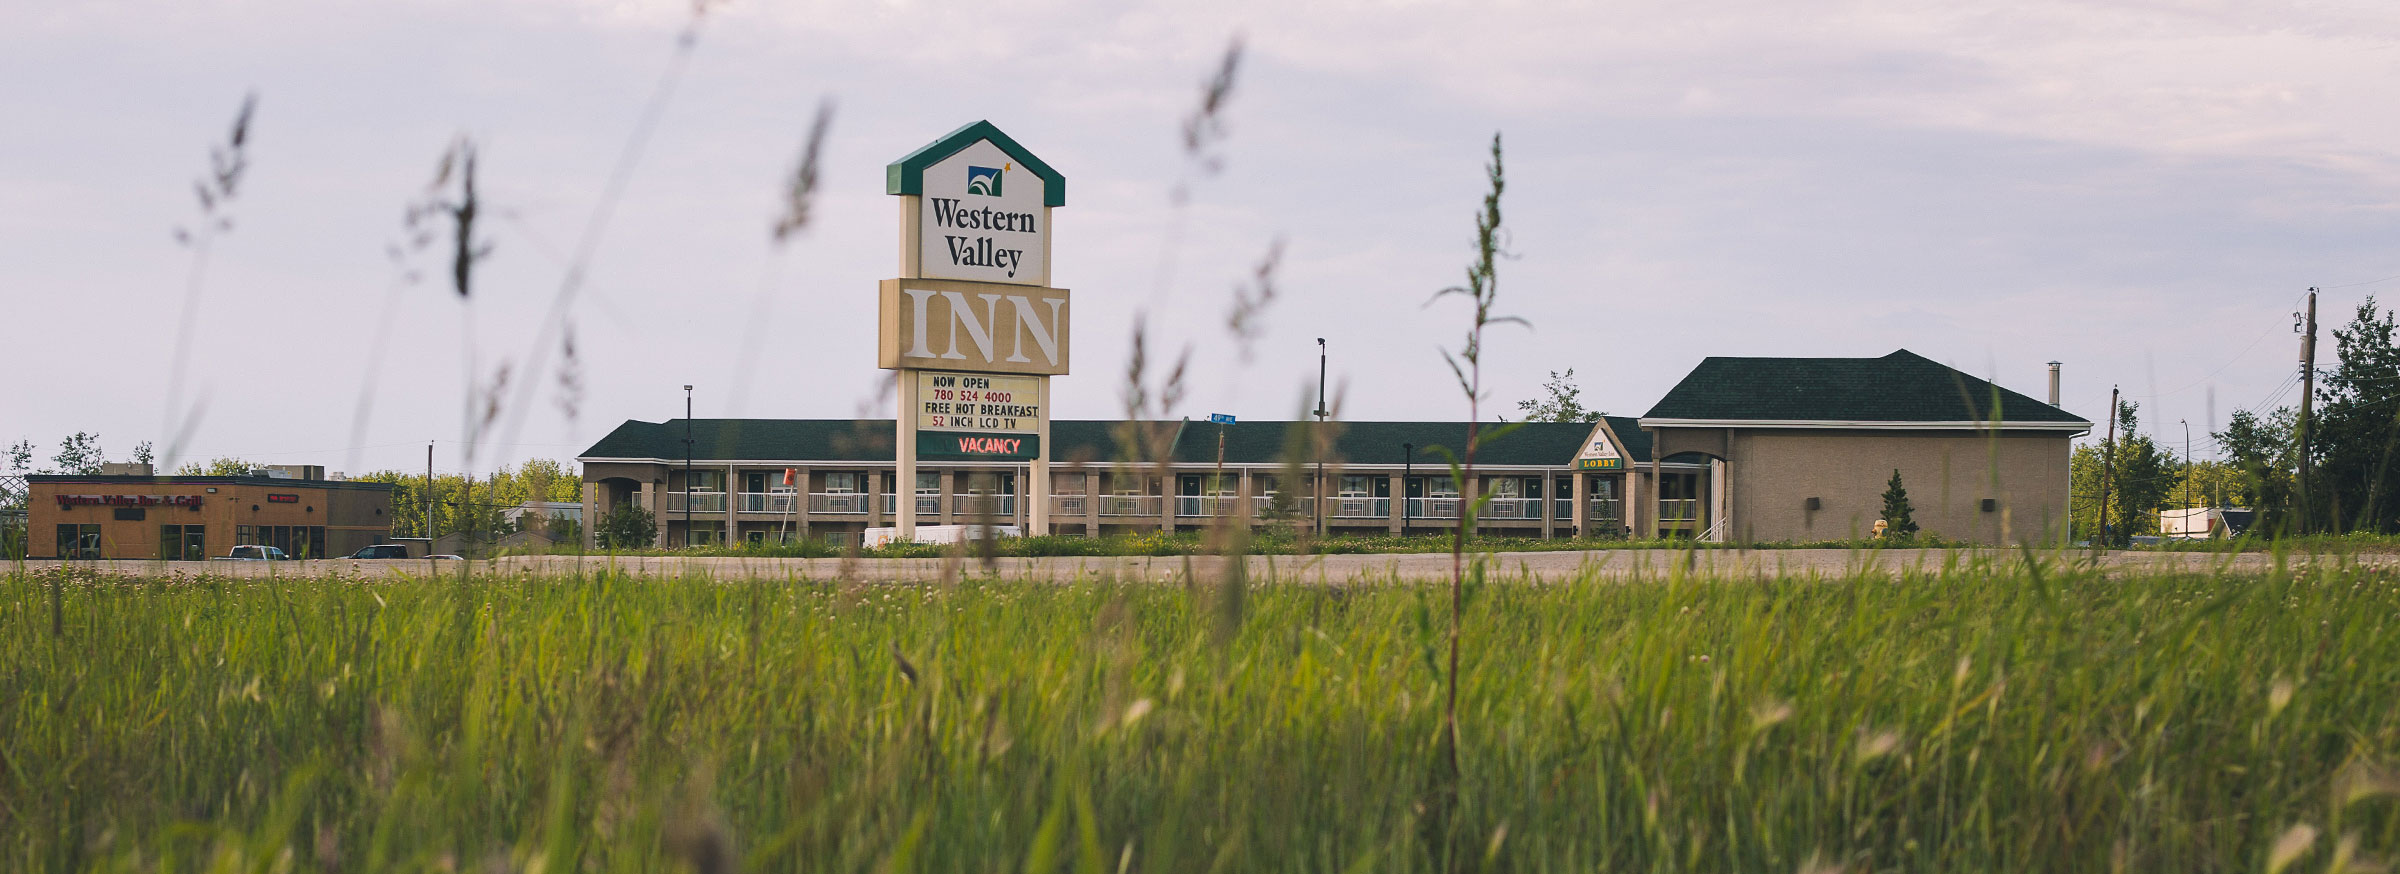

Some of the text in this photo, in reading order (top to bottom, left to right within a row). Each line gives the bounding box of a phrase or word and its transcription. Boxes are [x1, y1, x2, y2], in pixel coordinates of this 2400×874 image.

[931, 197, 1036, 233] Western
[945, 235, 1023, 278] Valley
[904, 288, 1065, 367] INN
[933, 376, 989, 389] NOW OPEN
[934, 389, 1011, 403] 780 524 4000
[925, 402, 1038, 417] FREE HOT BREAKFAST
[932, 415, 1016, 429] 52 INCH LCD TV
[958, 437, 1021, 454] VACANCY
[1583, 459, 1615, 467] LOBBY
[56, 494, 99, 505] Western
[102, 494, 136, 508] Valley
[138, 494, 159, 505] Bar
[174, 494, 202, 505] Grill
